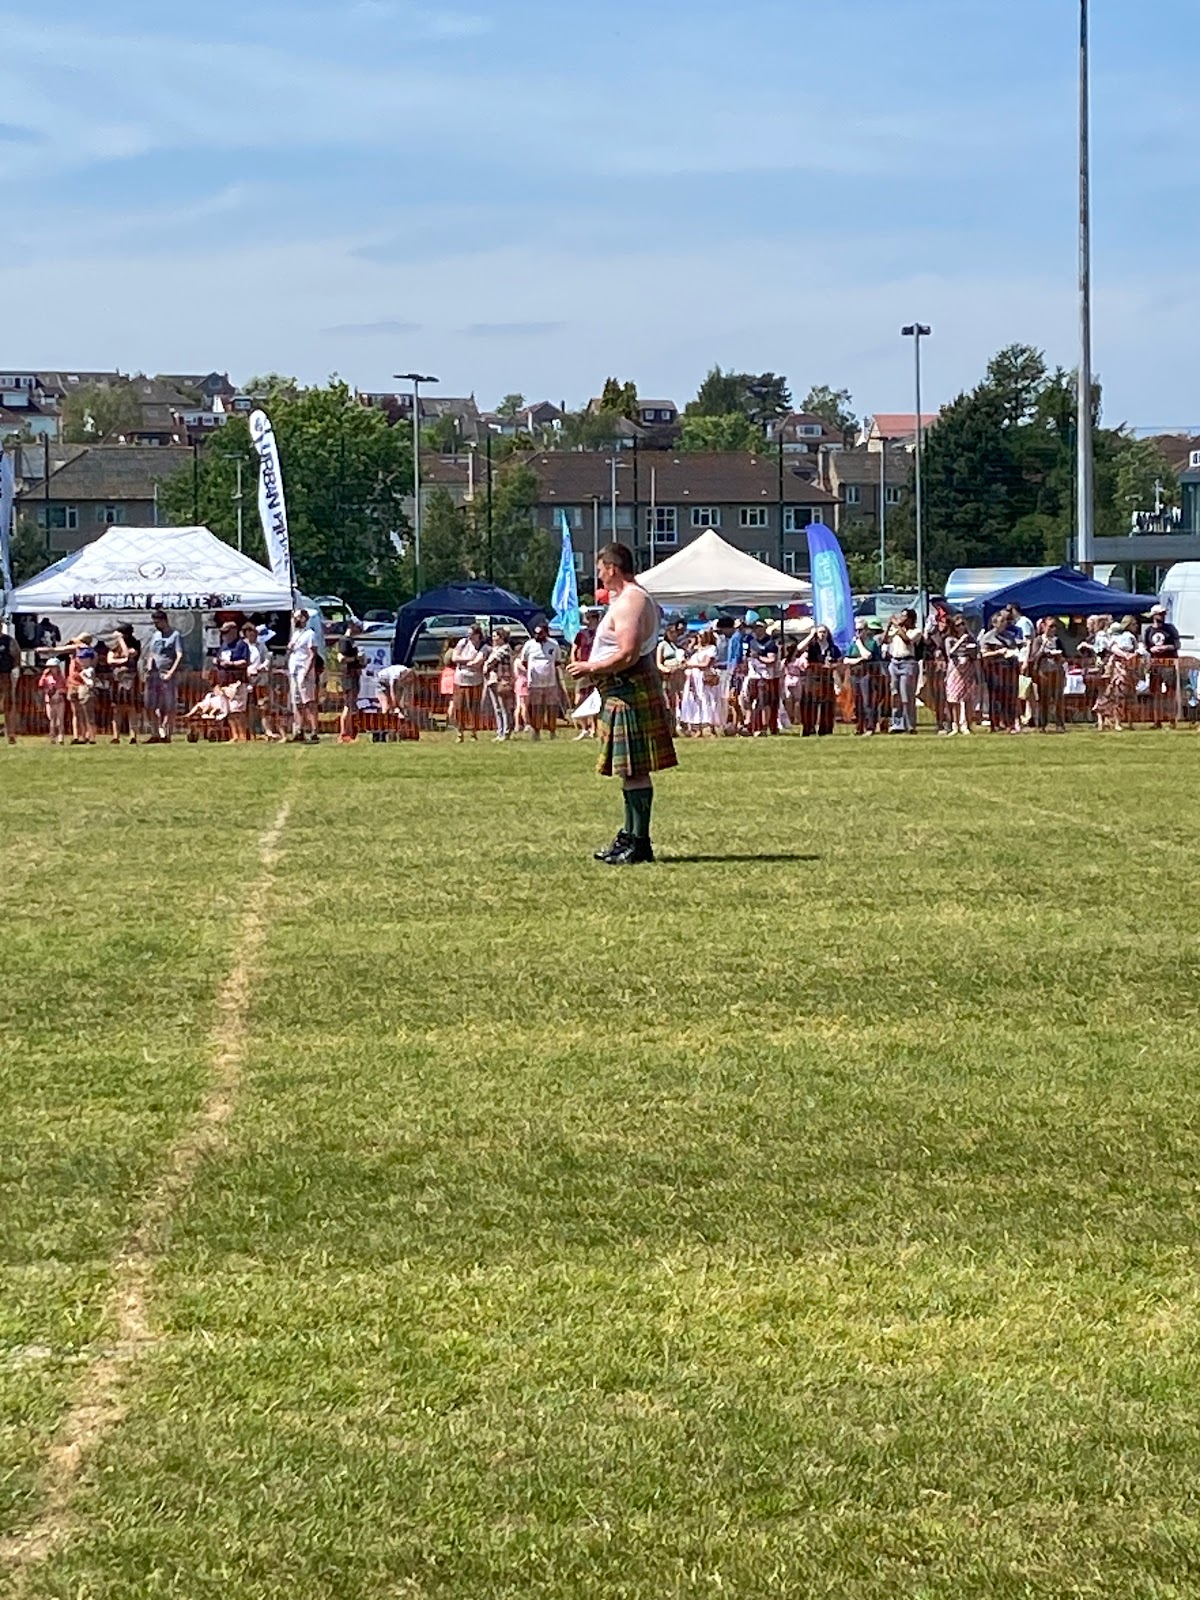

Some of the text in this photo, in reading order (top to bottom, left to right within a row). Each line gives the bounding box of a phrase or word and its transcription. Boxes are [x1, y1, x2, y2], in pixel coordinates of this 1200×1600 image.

[260, 443, 281, 510] URBAN
[95, 594, 209, 608] URBAN PIRATE
